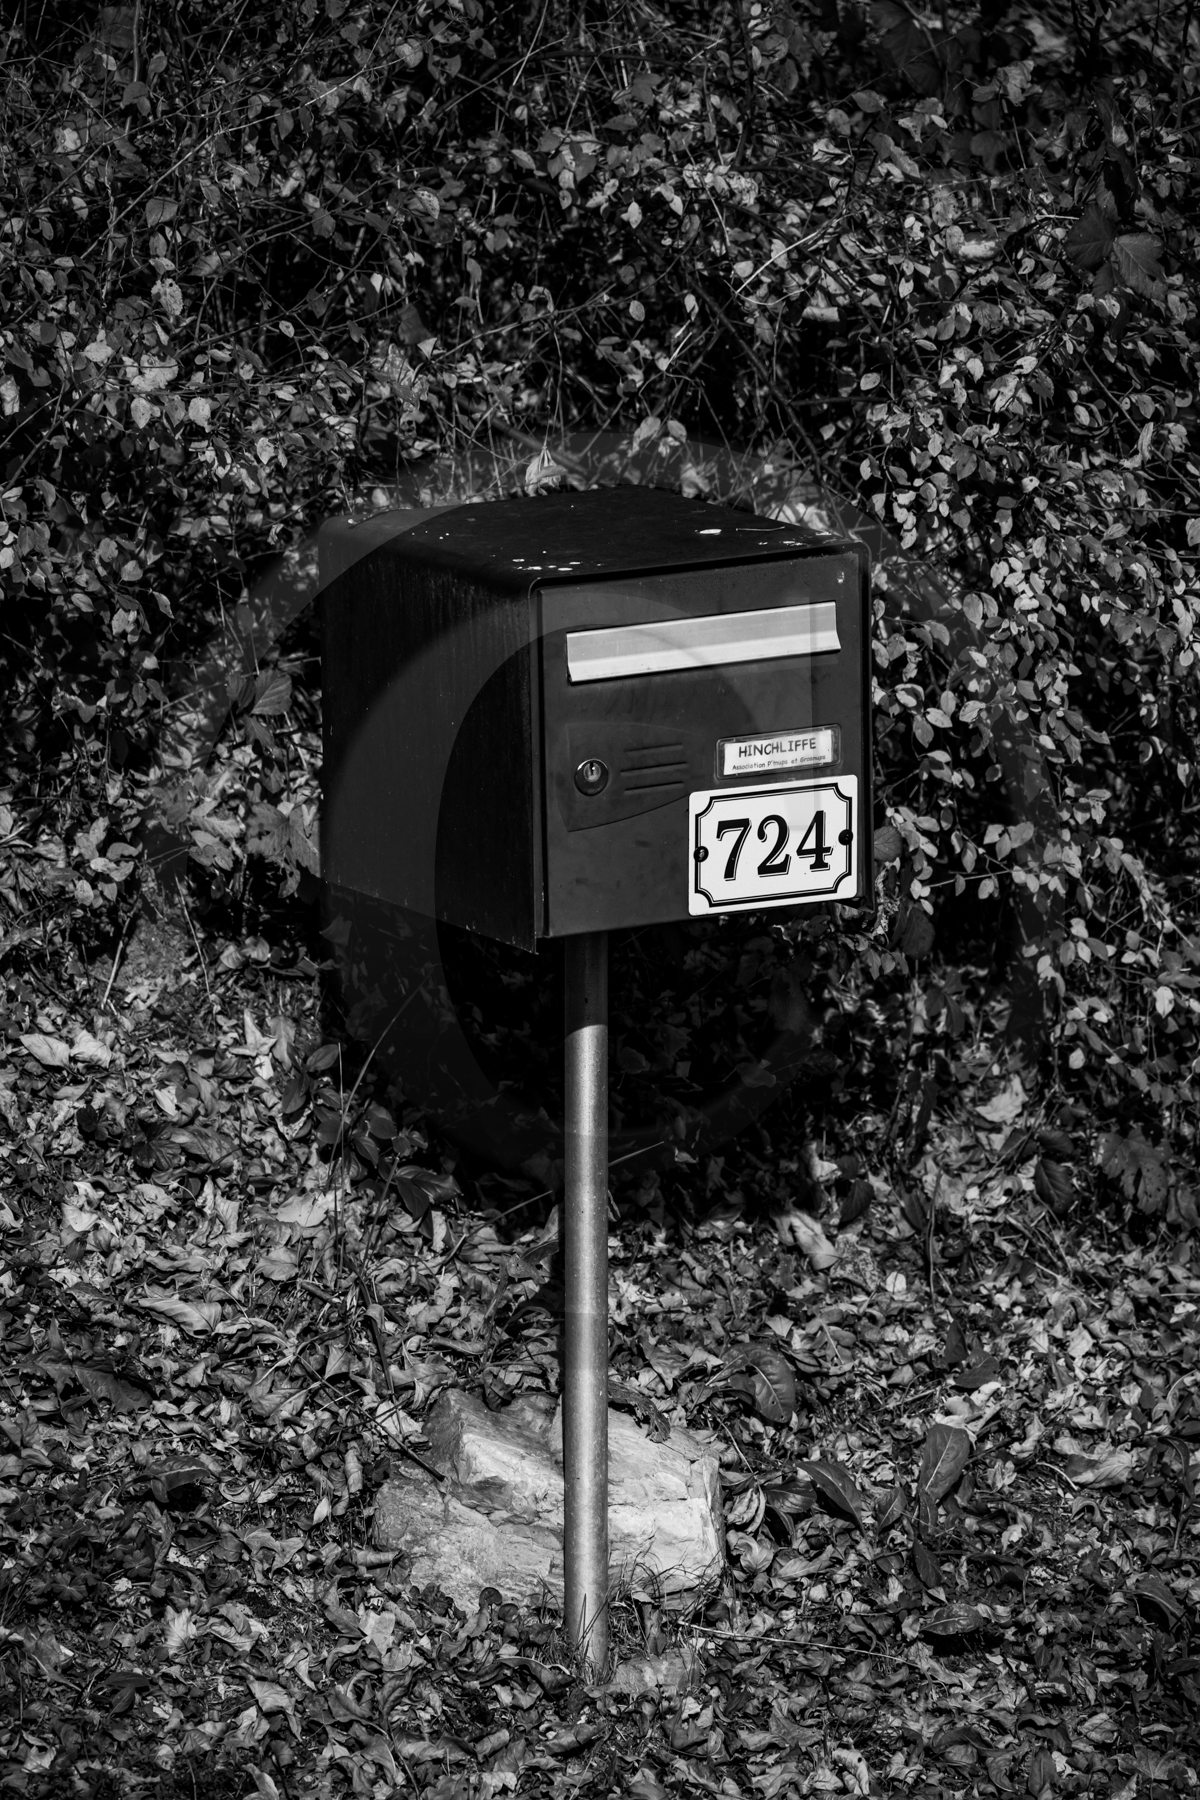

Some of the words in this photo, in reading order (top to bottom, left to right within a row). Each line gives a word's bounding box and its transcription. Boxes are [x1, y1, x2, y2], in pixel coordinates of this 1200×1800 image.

[738, 737, 816, 757] HINCHLIFFE
[732, 761, 765, 770] Association
[716, 810, 833, 881] 724
